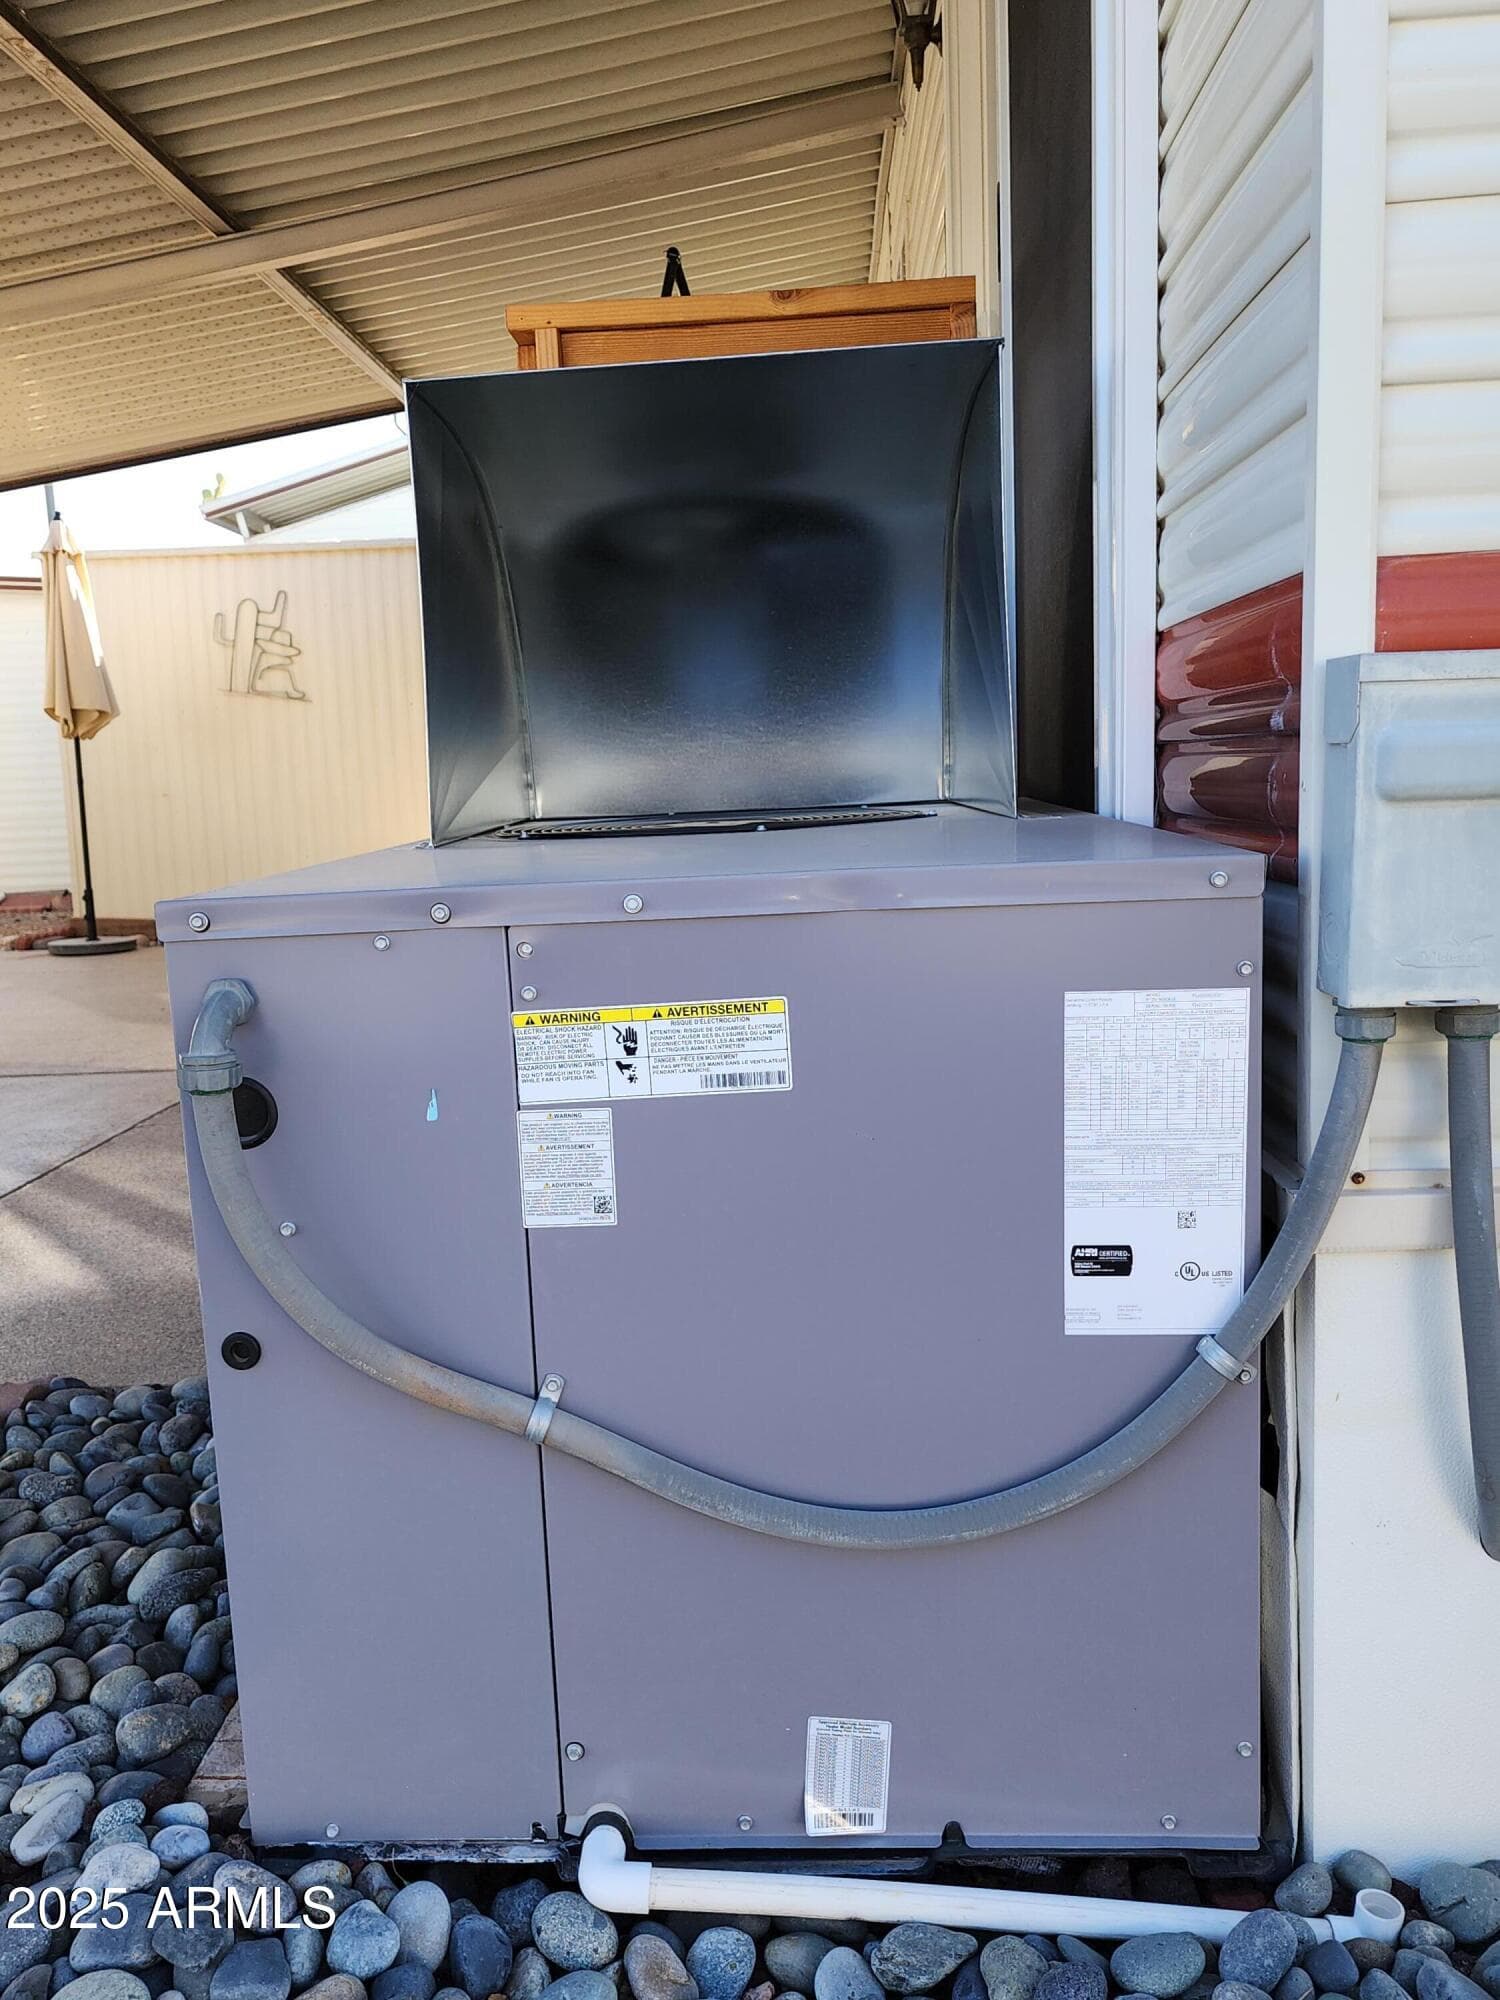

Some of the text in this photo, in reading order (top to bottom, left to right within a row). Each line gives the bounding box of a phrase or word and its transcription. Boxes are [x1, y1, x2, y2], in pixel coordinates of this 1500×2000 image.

[667, 1001, 769, 1018] AVERTISSEMENT
[540, 1011, 601, 1025] WARNING
[516, 1024, 602, 1035] ELECTRICAL SHOCK HAZARD
[518, 1063, 557, 1071] HAZARDOUS
[558, 1061, 583, 1069] MOVING
[545, 1143, 595, 1151] AVERTISSEMENT
